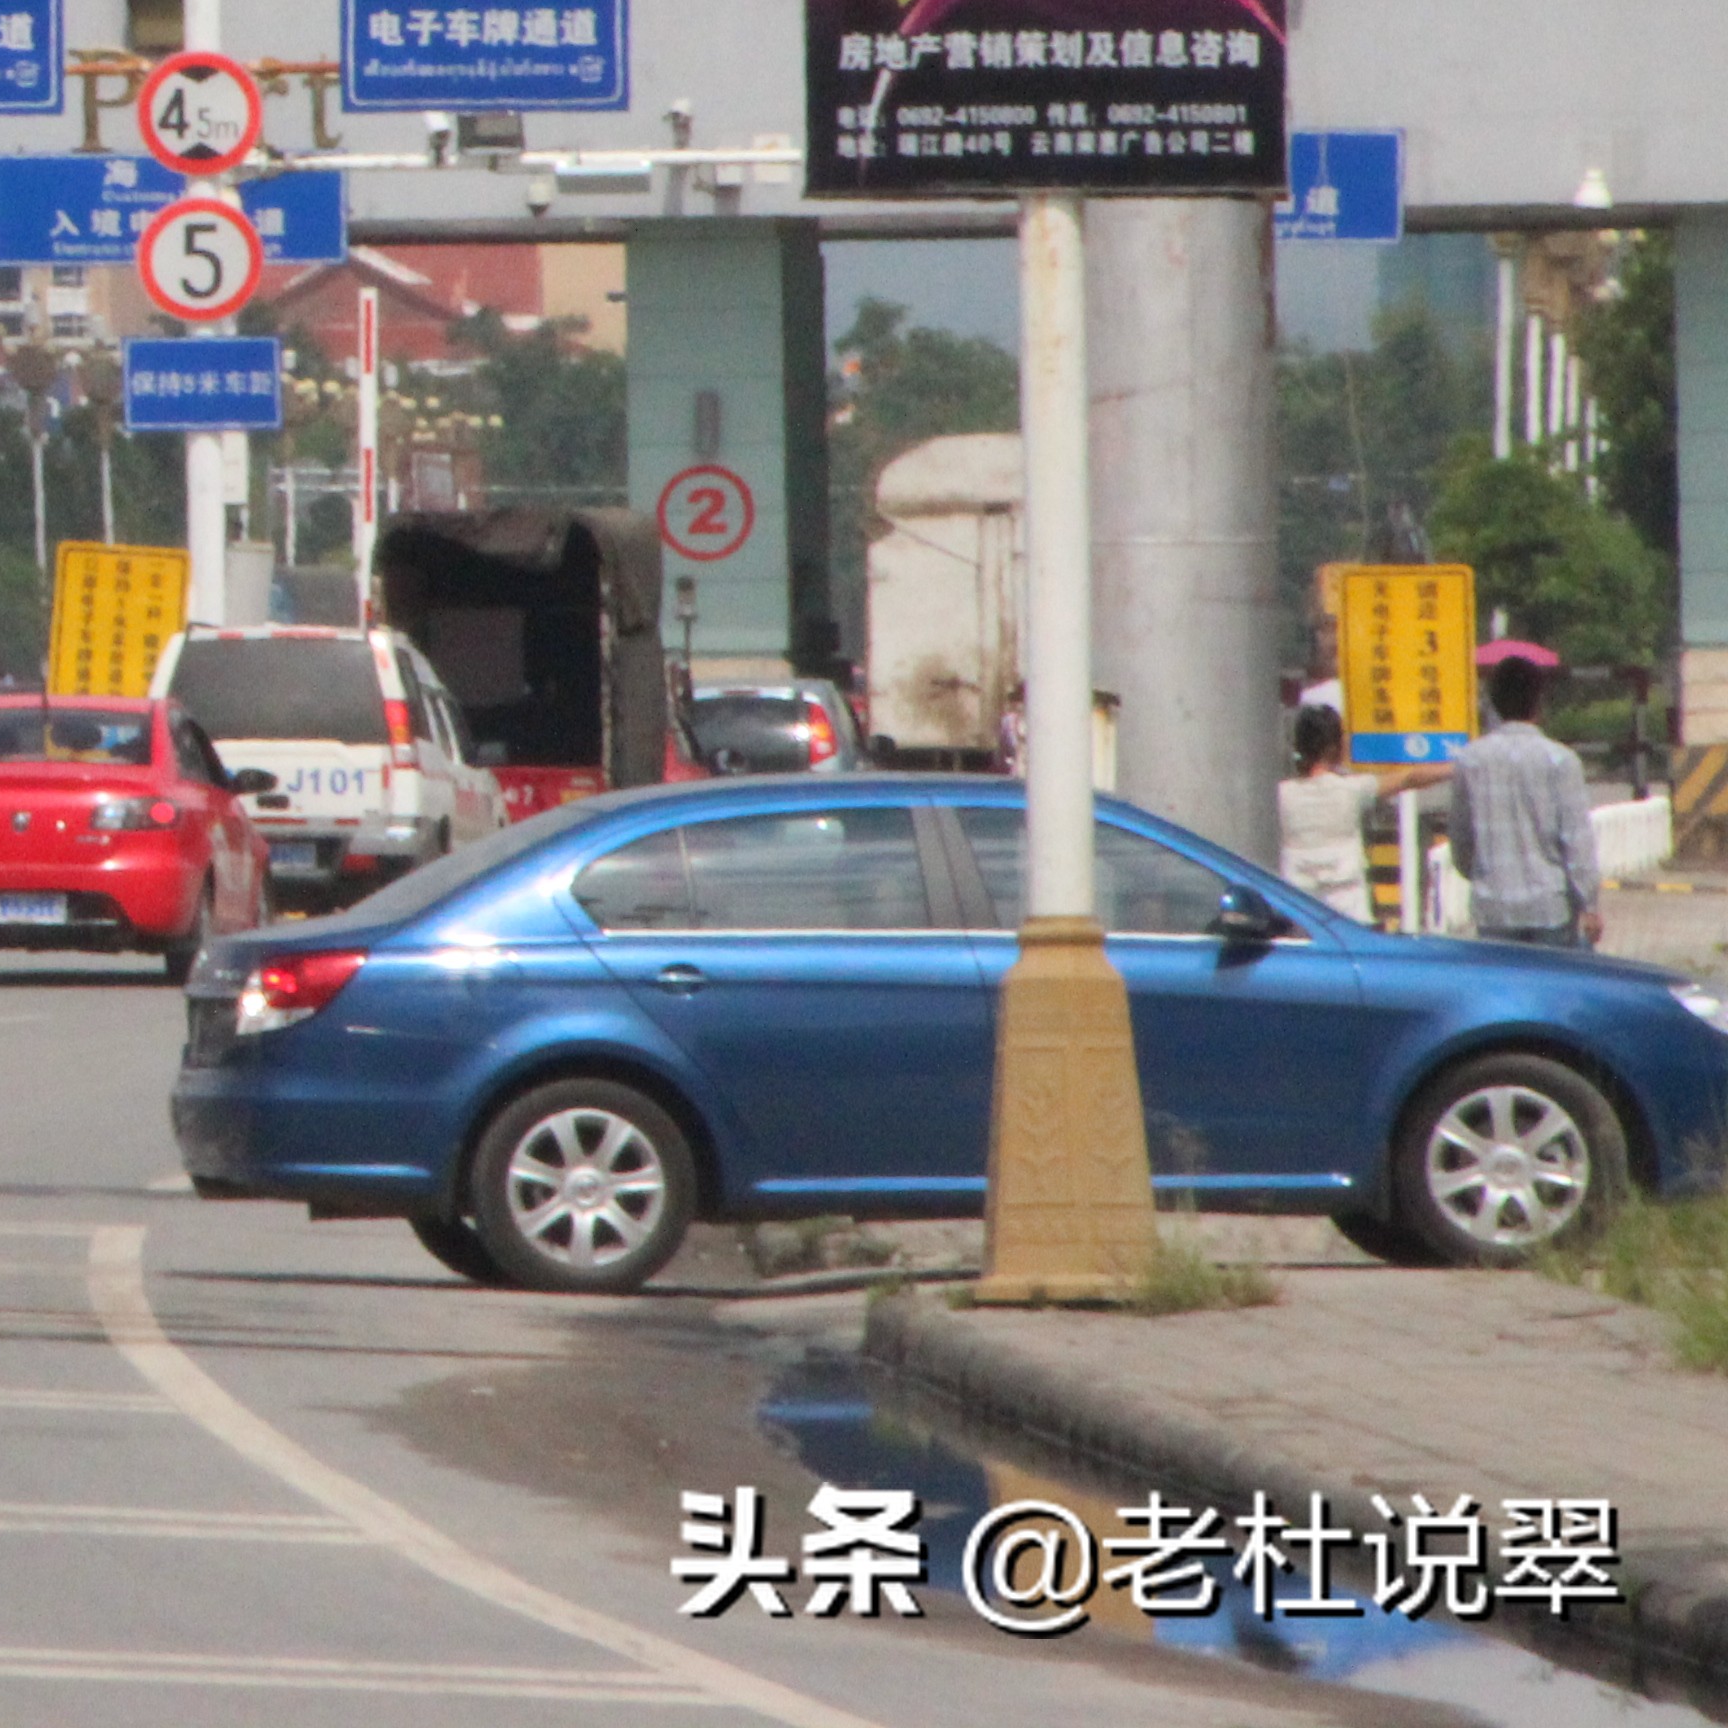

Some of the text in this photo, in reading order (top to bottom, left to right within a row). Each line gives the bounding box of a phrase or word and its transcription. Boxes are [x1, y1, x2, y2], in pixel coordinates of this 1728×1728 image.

[368, 8, 597, 47] 电子车牌通道
[839, 30, 1260, 69] 房地产营销策划及信息咨询
[181, 224, 222, 298] 5
[687, 487, 728, 535] 2
